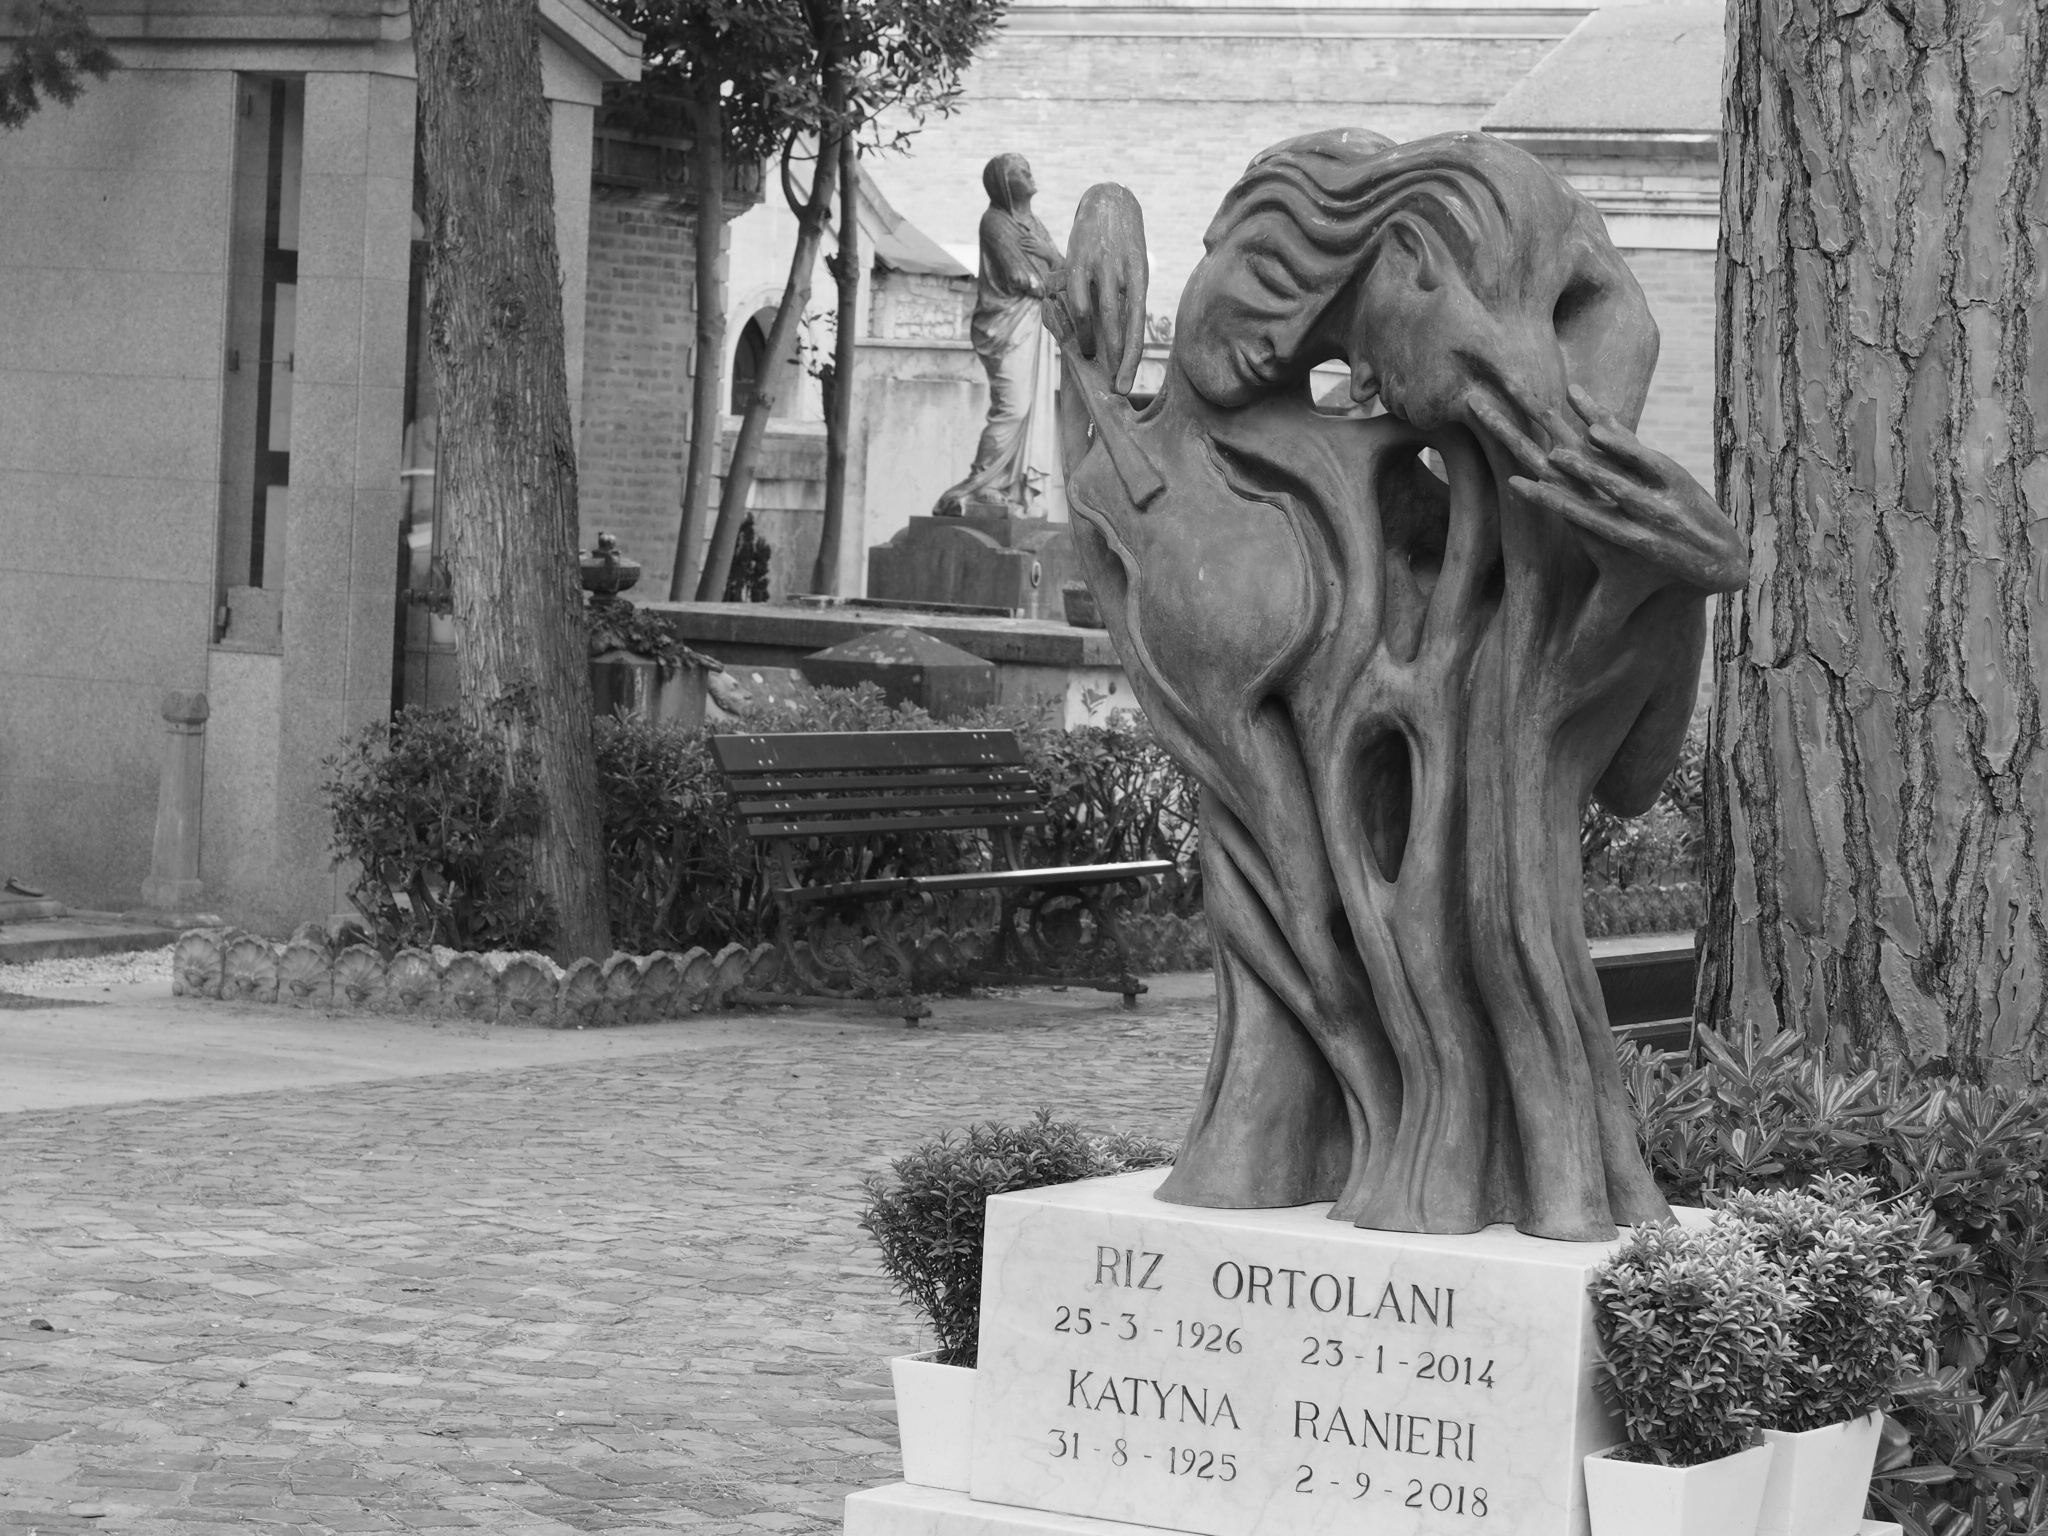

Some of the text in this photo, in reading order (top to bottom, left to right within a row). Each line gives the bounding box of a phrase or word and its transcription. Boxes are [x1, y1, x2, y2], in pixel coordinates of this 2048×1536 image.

[1094, 1245, 1456, 1329] RIZ ORTOLANI
[1066, 1368, 1476, 1463] KATYNA RANIERI
